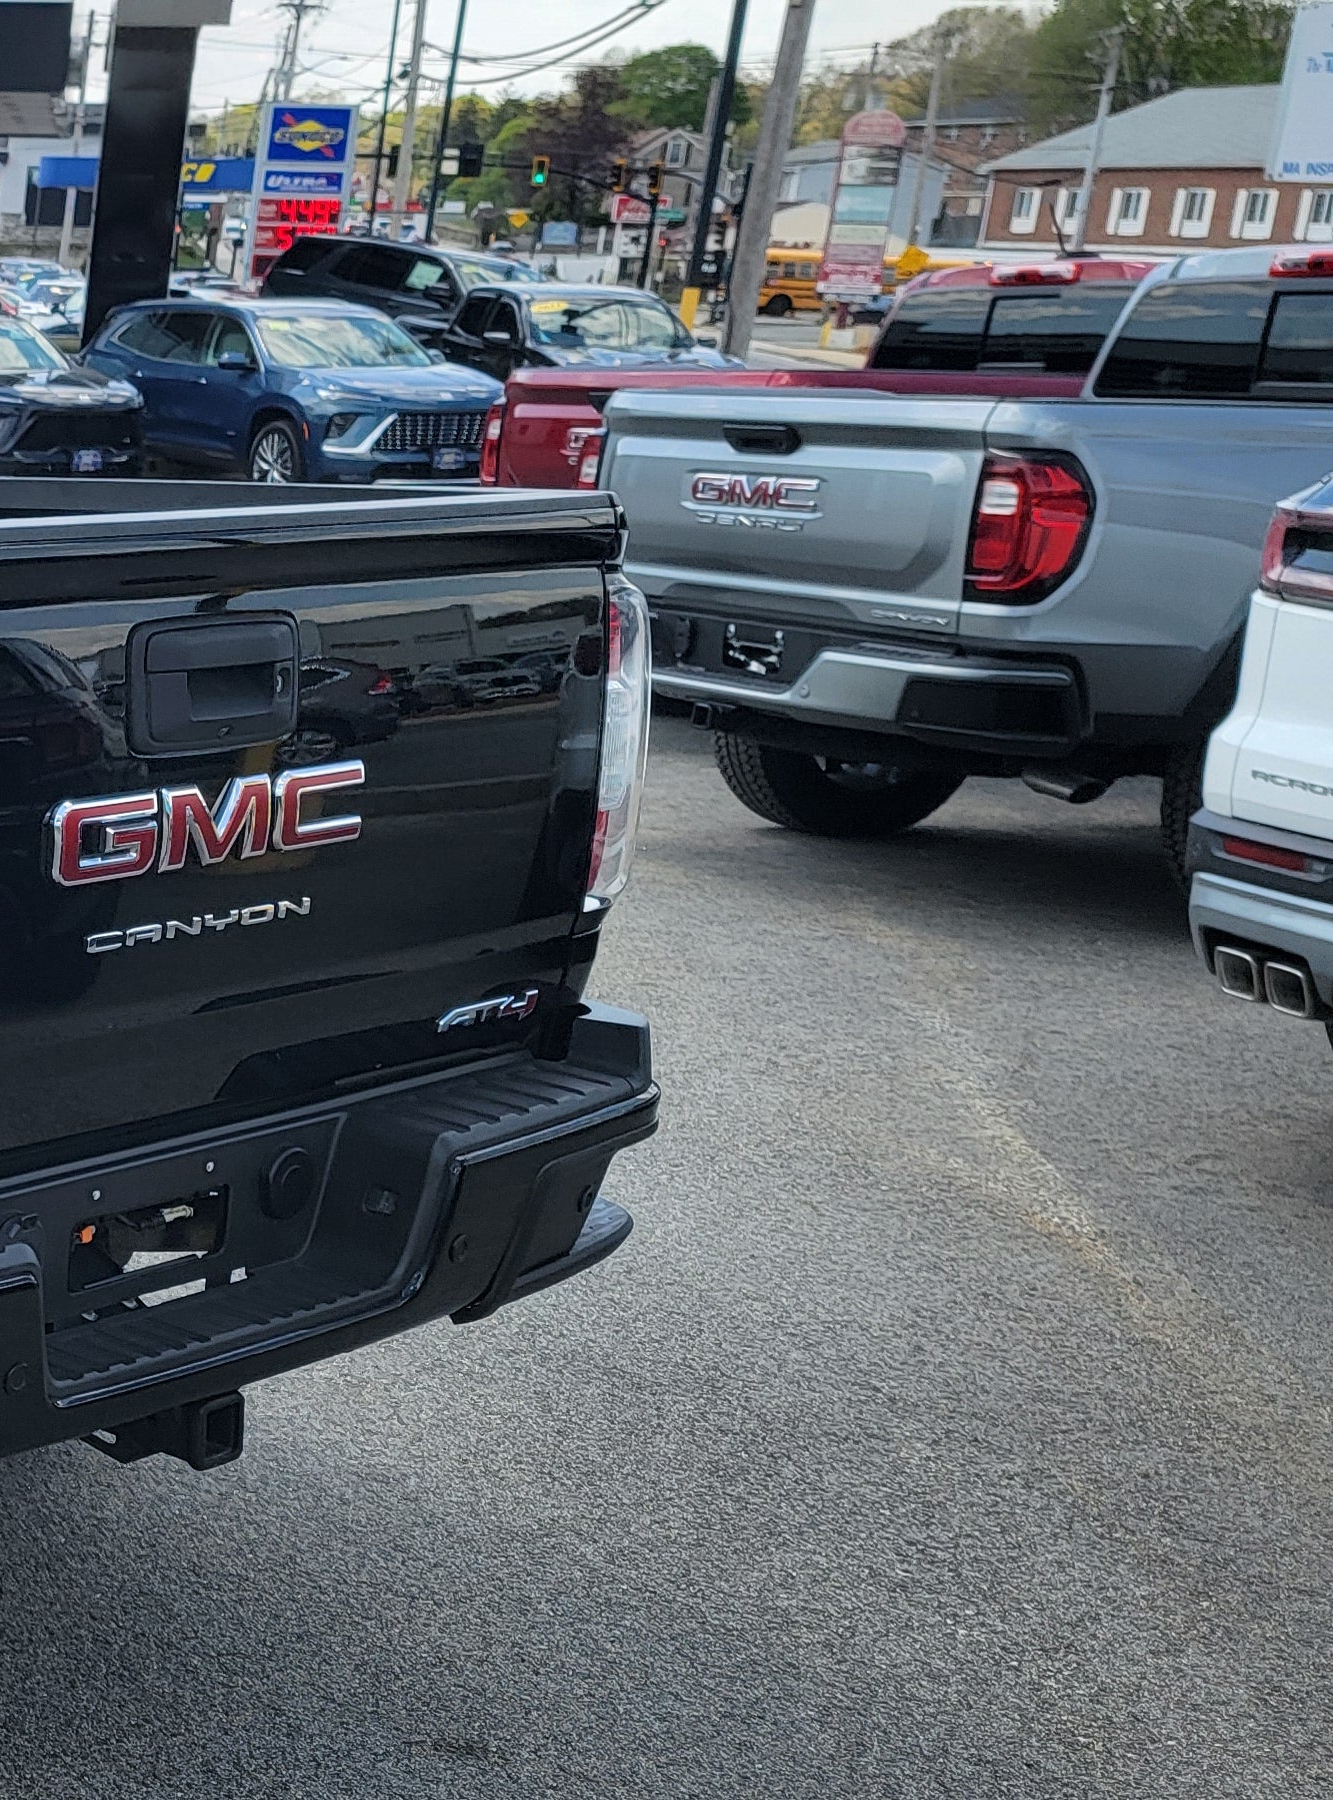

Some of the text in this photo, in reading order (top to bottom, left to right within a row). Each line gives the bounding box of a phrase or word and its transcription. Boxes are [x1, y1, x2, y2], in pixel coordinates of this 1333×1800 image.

[691, 473, 820, 512] GMC
[50, 759, 366, 887] GMC
[85, 896, 312, 955] CANYON
